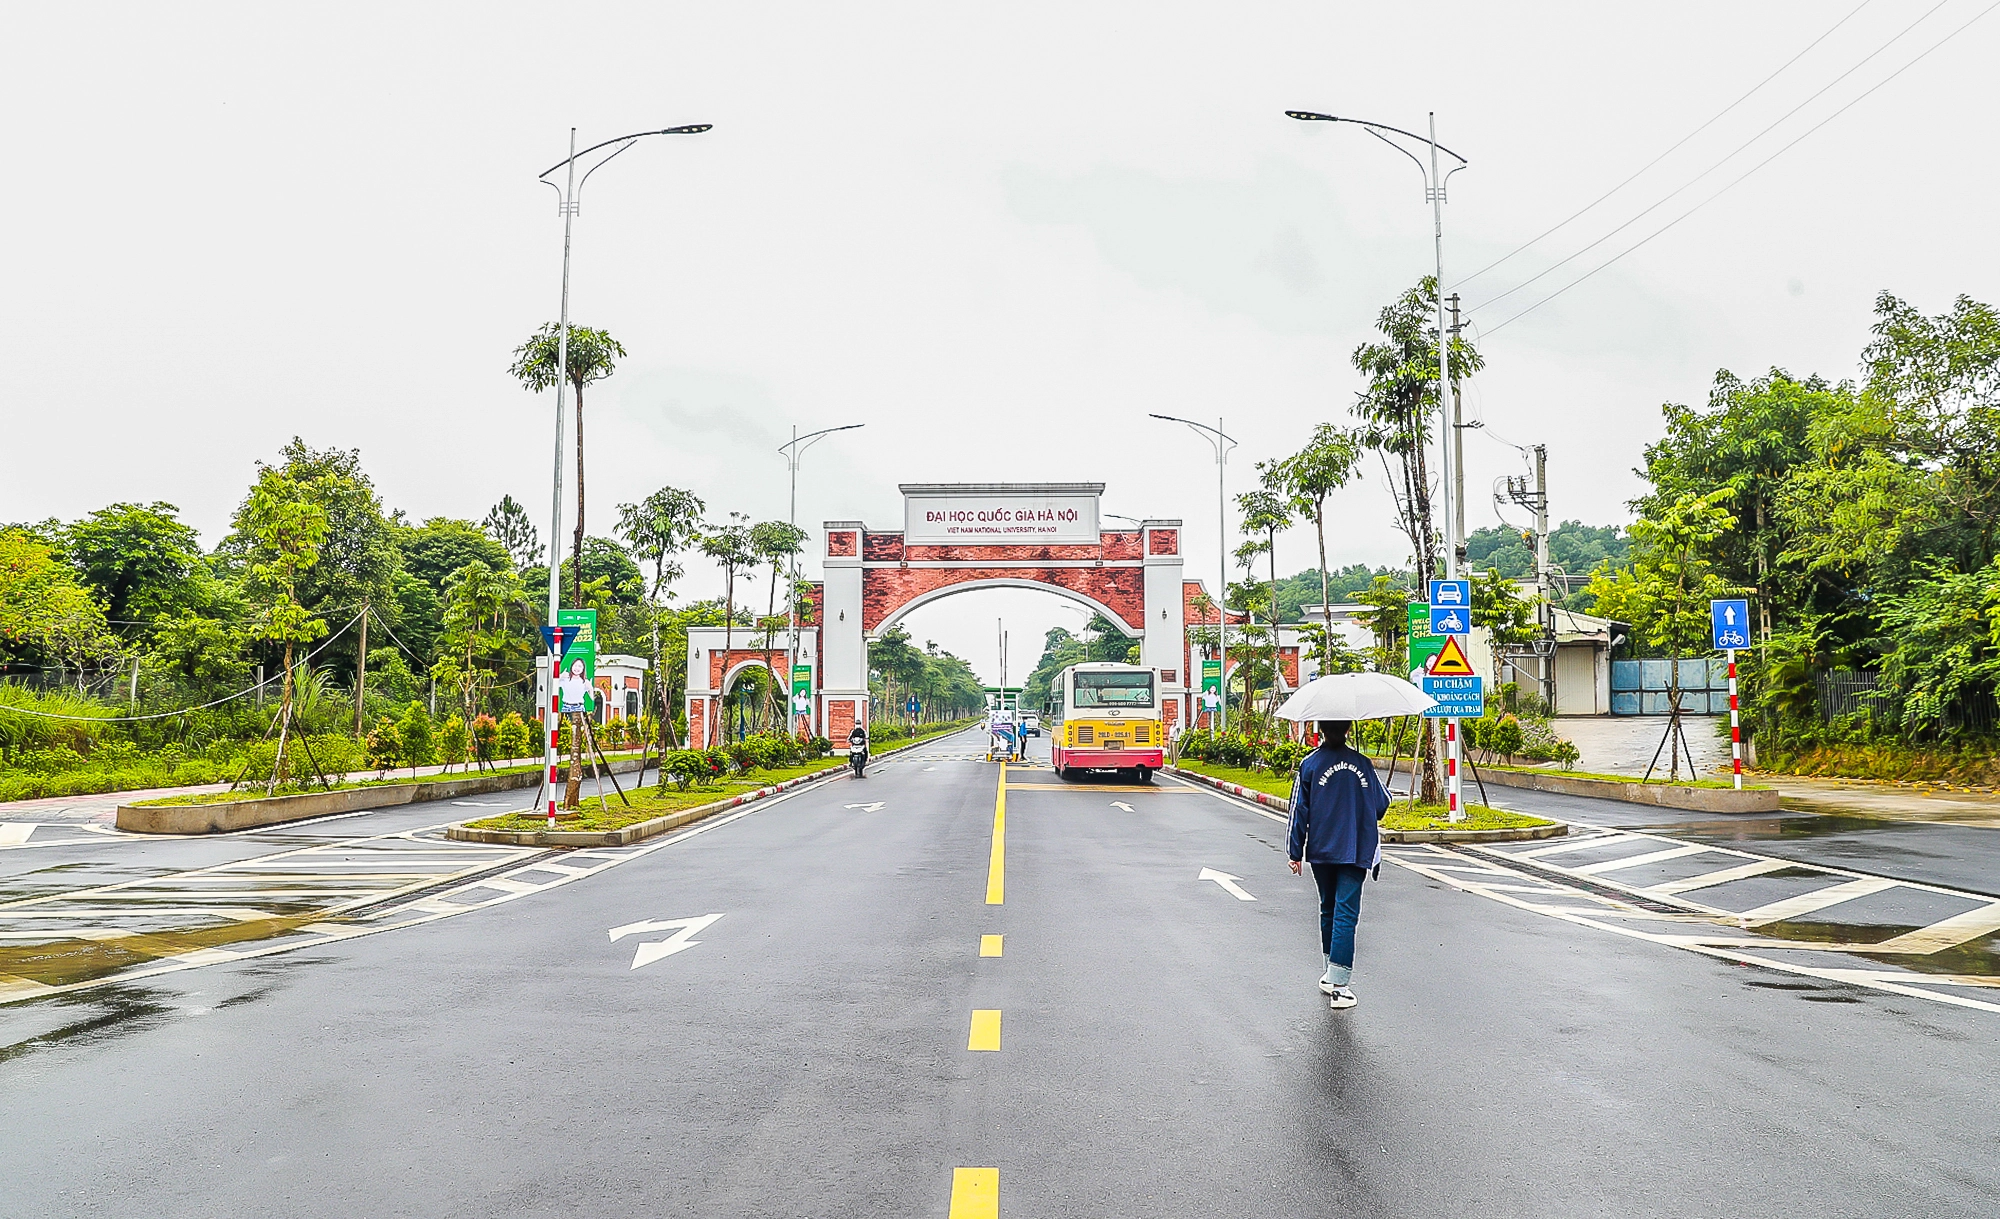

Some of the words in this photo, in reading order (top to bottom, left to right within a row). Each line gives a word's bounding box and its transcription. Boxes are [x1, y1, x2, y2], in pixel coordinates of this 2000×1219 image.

[926, 511, 946, 524] ĐẠI
[949, 511, 974, 524] HỌC
[977, 507, 1011, 523] QUỐC
[1038, 508, 1054, 521] HÀ
[1057, 508, 1078, 523] NỘI
[1445, 677, 1473, 690] CHẬM
[1463, 690, 1480, 701] CÁCH
[1452, 705, 1464, 714] QUA
